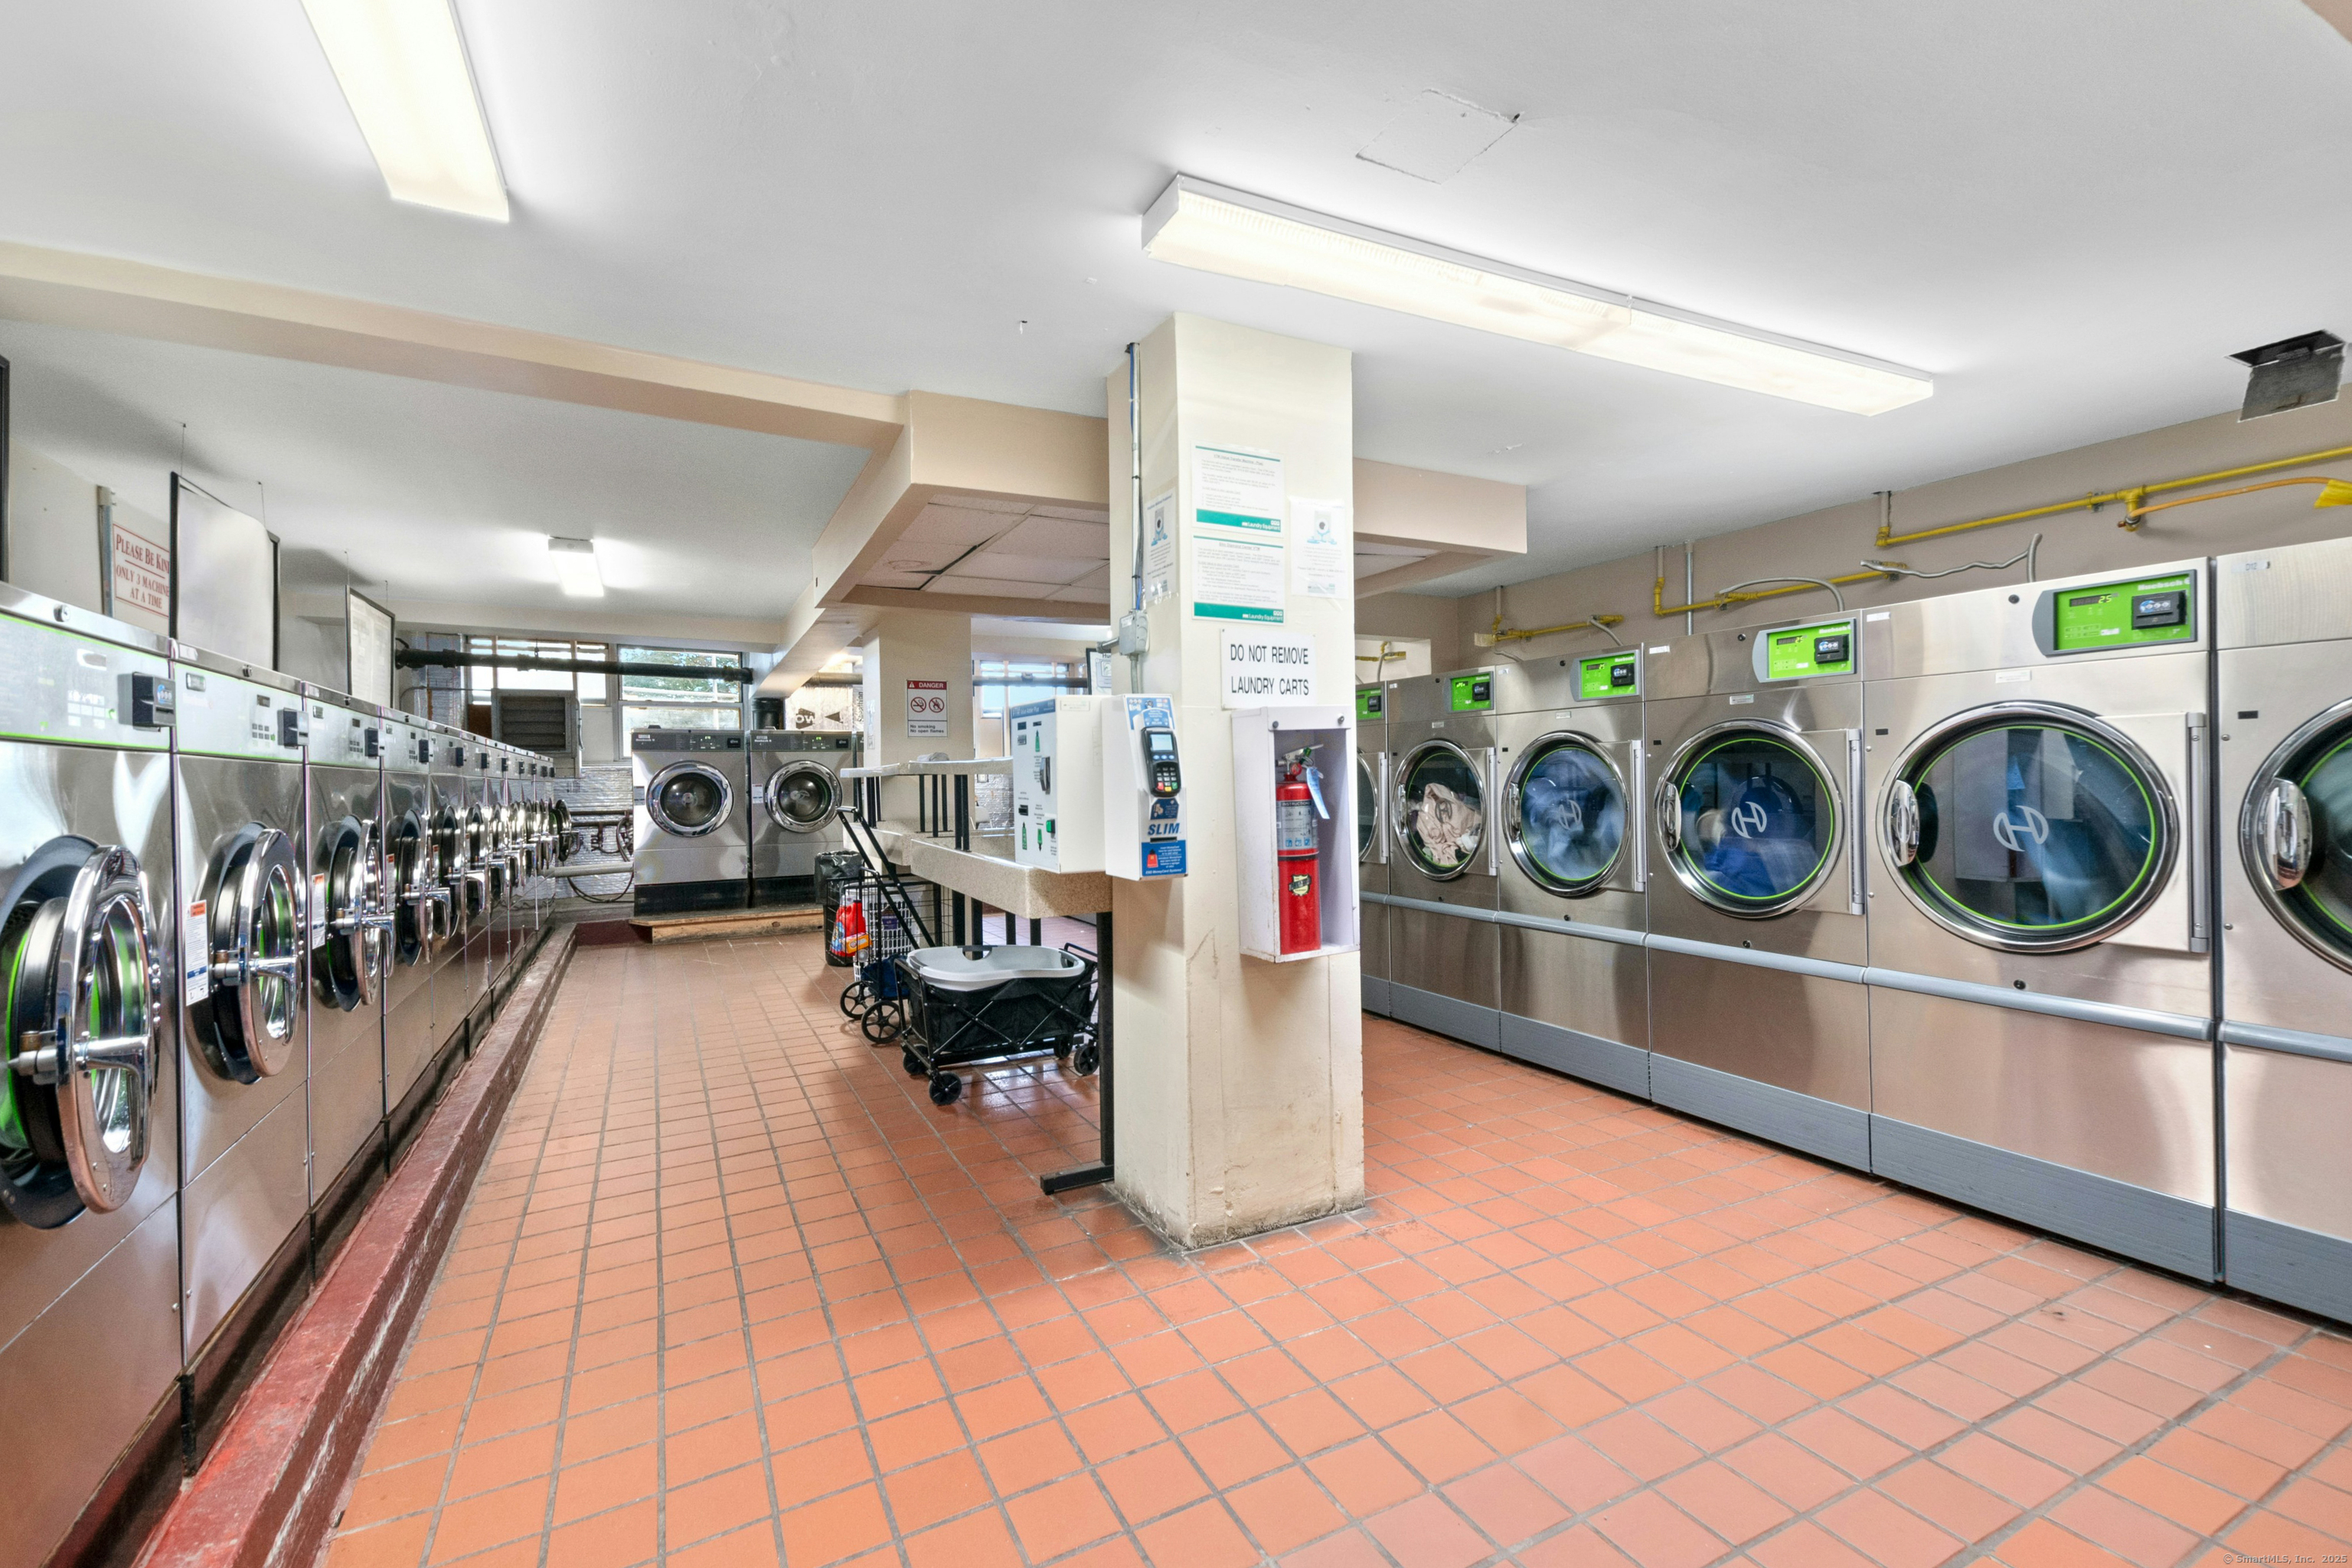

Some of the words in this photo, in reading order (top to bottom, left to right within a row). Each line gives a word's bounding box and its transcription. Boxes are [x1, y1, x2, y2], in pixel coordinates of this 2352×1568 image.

[116, 534, 143, 561] PLEASE
[145, 547, 155, 567] BE
[116, 564, 135, 583] ONLY
[137, 573, 140, 585] 3
[130, 587, 139, 600] AT
[141, 591, 145, 603] A
[148, 593, 162, 609] TIME
[2099, 595, 2112, 603] 25
[1230, 644, 1245, 662] DO
[1248, 645, 1267, 662] NOT
[1272, 646, 1309, 665] REMOVE
[1231, 676, 1274, 694] LAUNDRY
[1279, 678, 1309, 696] CARTS
[1147, 823, 1180, 836] SLIM
